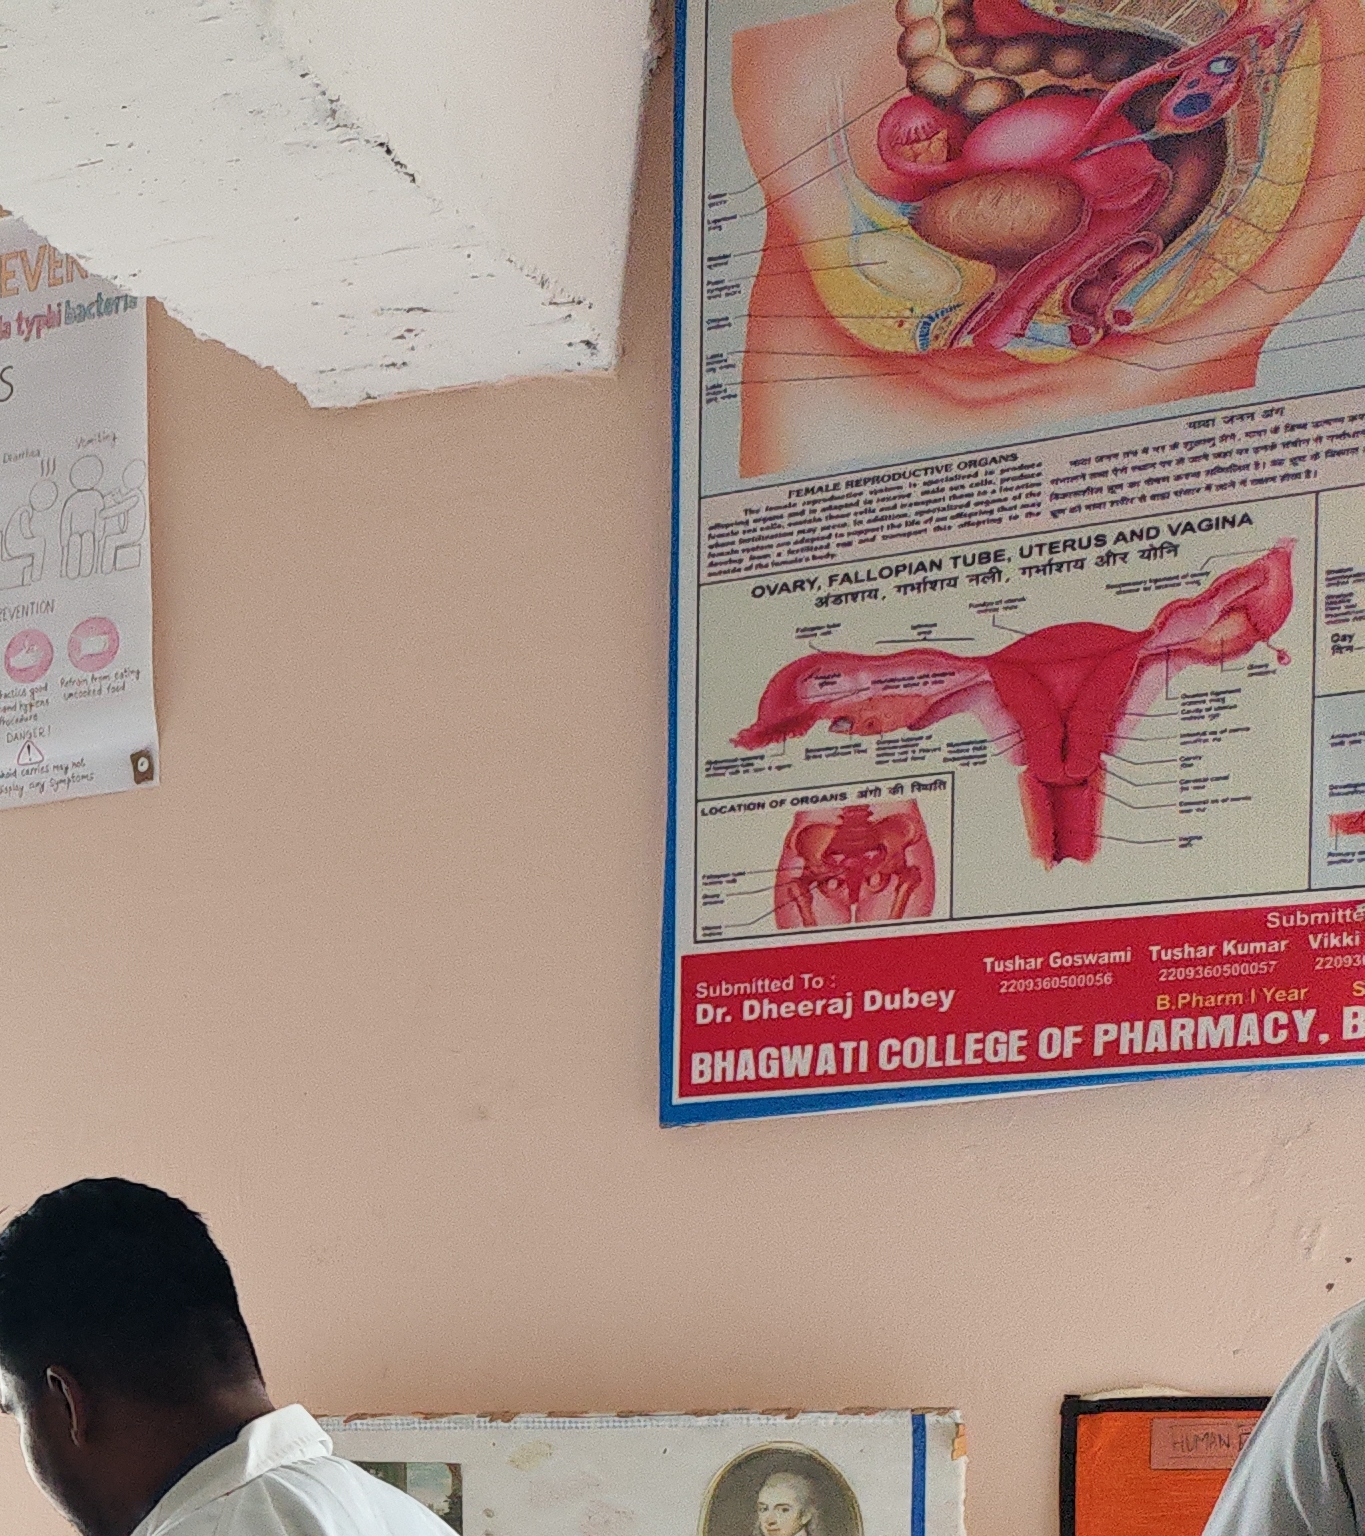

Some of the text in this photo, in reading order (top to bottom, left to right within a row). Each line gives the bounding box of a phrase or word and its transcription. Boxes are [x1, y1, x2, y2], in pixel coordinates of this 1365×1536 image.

[16, 302, 61, 343] typhi
[64, 291, 138, 325] bacteria
[787, 452, 1019, 500] FEMALE REPRODUCTIVE ORGANS
[750, 511, 1254, 599] OVARY, FALLOPIAN TUBE, UTERUS AND VAGINA
[700, 791, 849, 817] LOCATION OF ORGANS
[983, 930, 1361, 974] Tushar Goswami Tushar Kumar Vikki
[695, 972, 825, 1000] Submitted To
[695, 986, 956, 1026] Dr. Dheeraj Dubey
[1156, 991, 1244, 1011] B.Pharm
[1261, 986, 1309, 1002] Year
[690, 1007, 1331, 1085] BHAGWATI COLLEGE OF PHARMACY,
